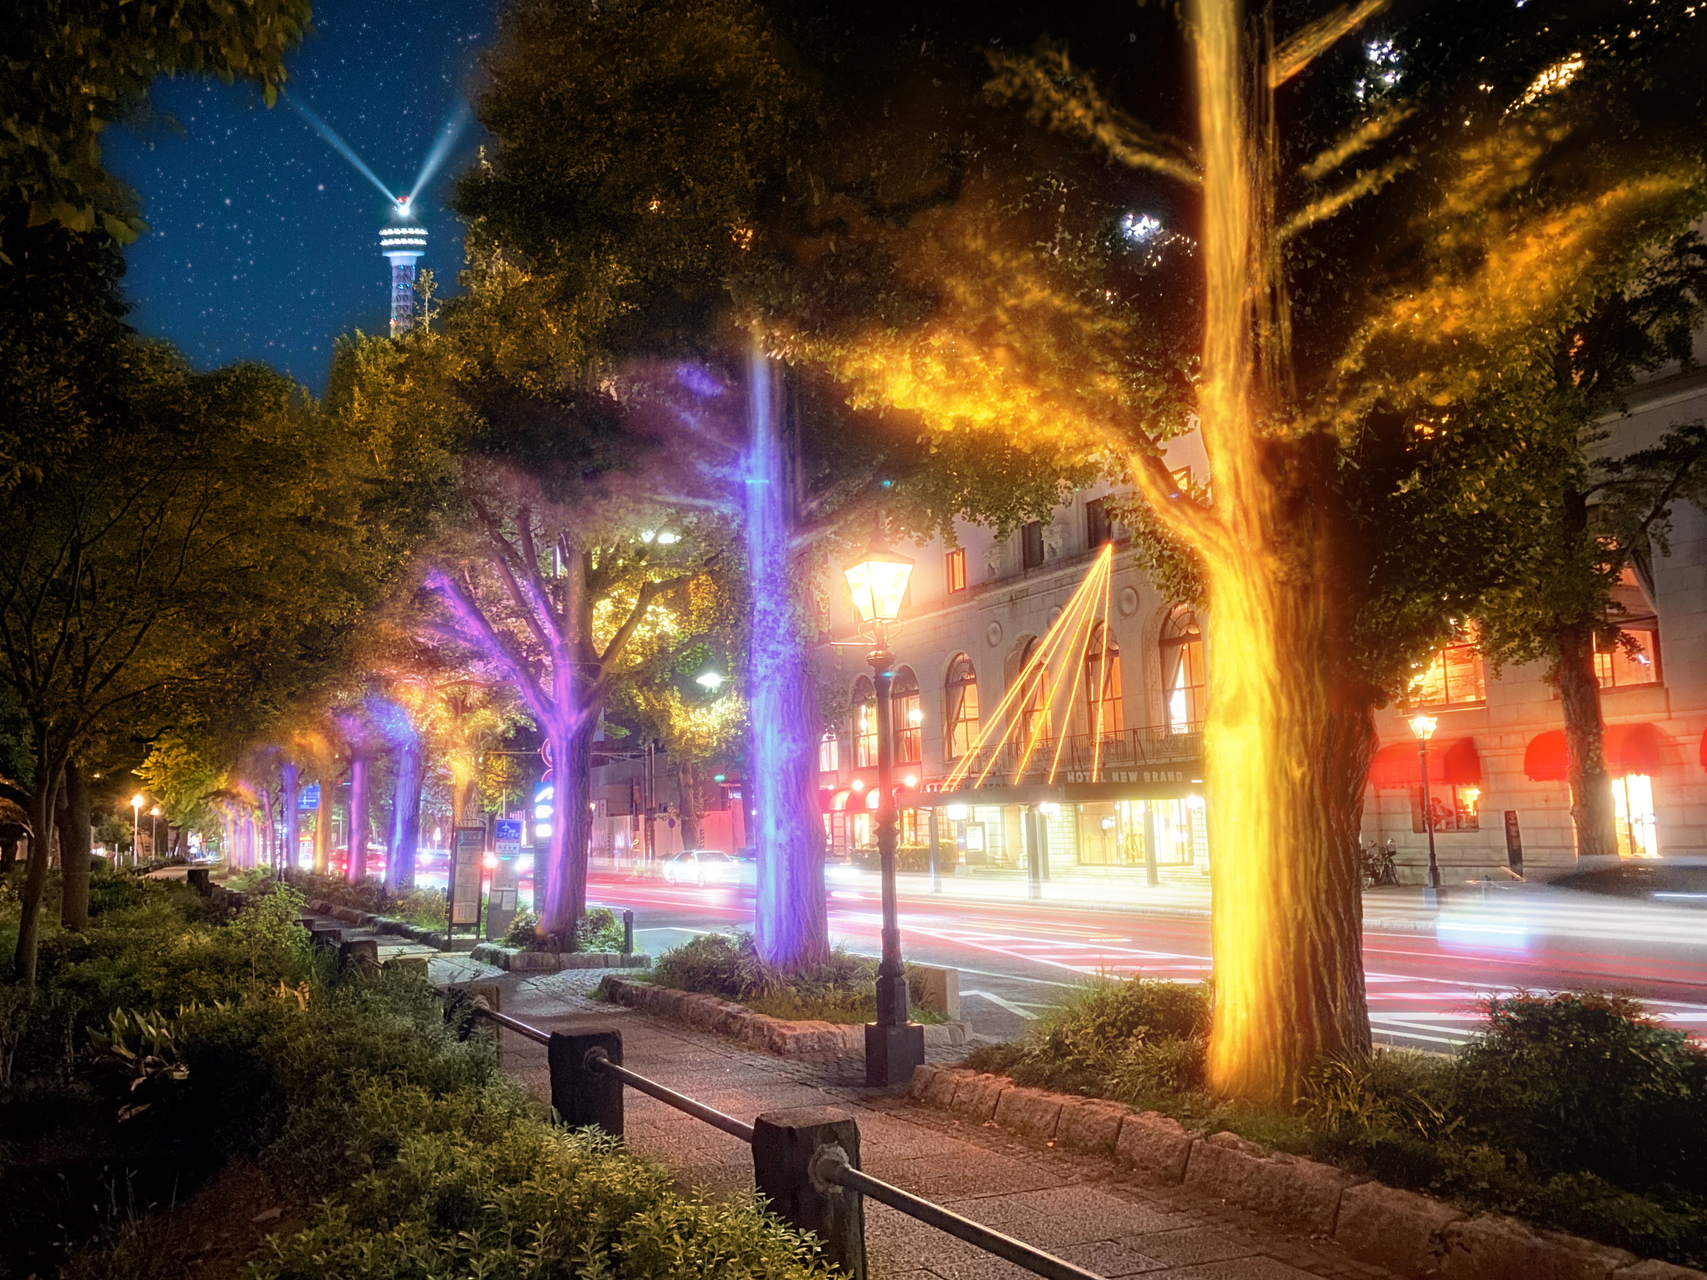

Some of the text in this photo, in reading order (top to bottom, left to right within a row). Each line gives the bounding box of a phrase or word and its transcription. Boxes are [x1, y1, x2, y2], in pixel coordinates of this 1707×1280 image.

[1067, 771, 1183, 783] HOTEL NEW GRAND
